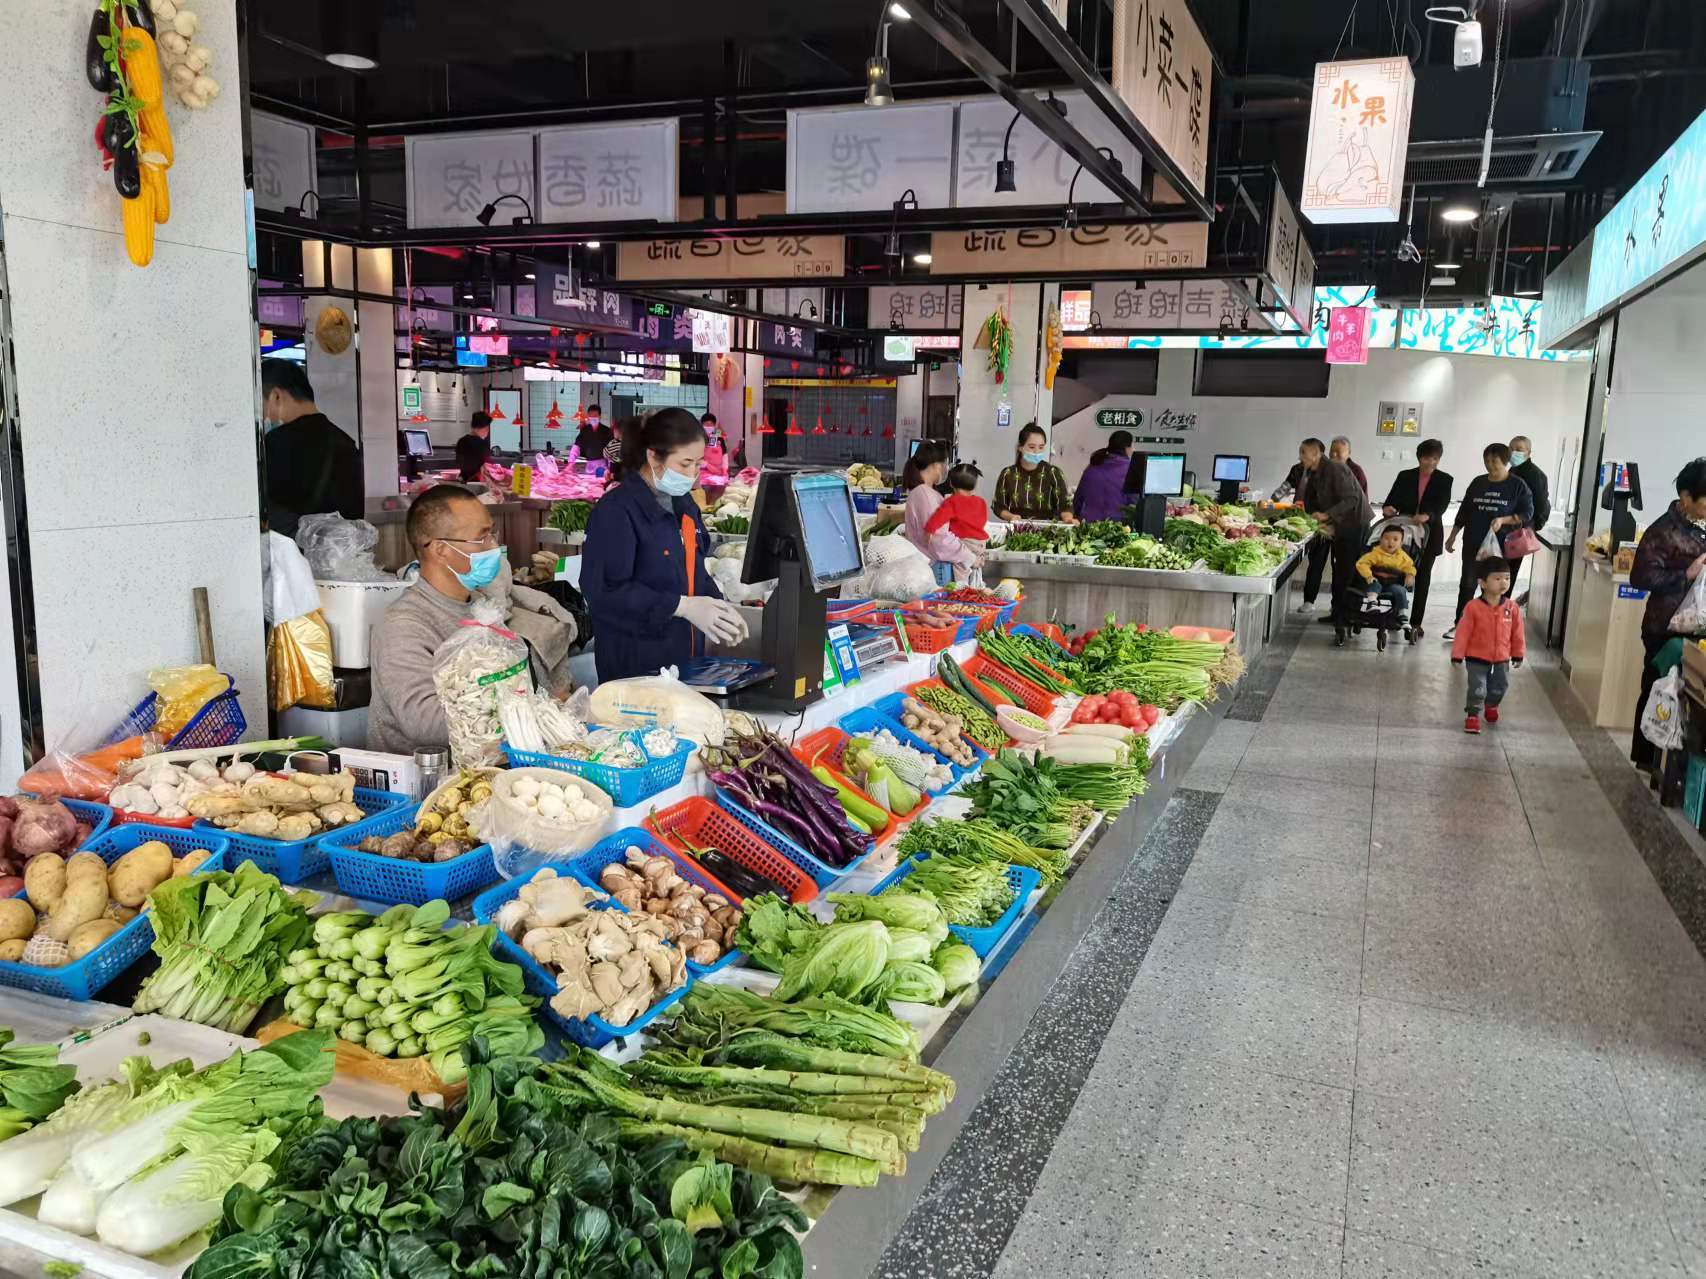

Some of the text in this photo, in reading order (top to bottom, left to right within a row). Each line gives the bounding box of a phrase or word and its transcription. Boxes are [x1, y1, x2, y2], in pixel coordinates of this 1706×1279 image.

[1136, 0, 1203, 150] 小菜一碟
[1332, 80, 1387, 128] 水果
[1102, 411, 1138, 425] 老相食
